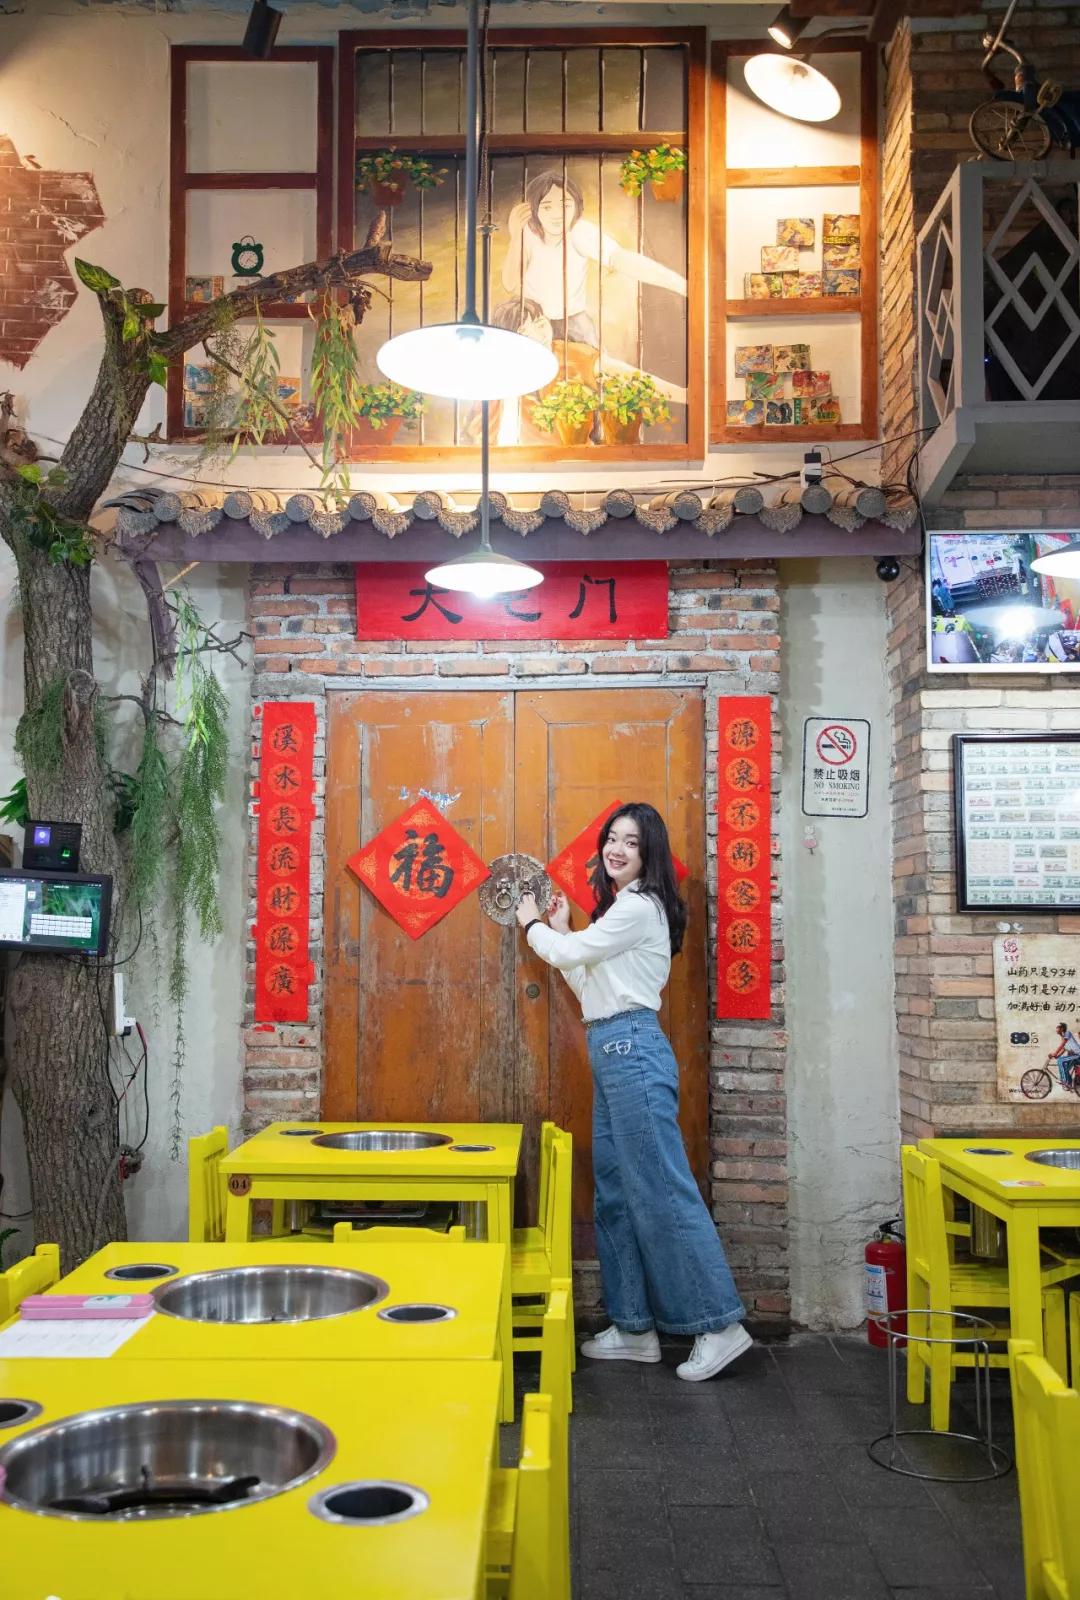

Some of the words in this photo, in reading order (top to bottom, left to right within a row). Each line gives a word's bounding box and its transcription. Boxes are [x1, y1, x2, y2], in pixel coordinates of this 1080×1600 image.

[813, 768, 860, 781] 禁止吸烟
[814, 781, 824, 789] NO
[829, 782, 860, 790] SMOKING
[390, 829, 455, 899] 福
[232, 1179, 247, 1190] 04
